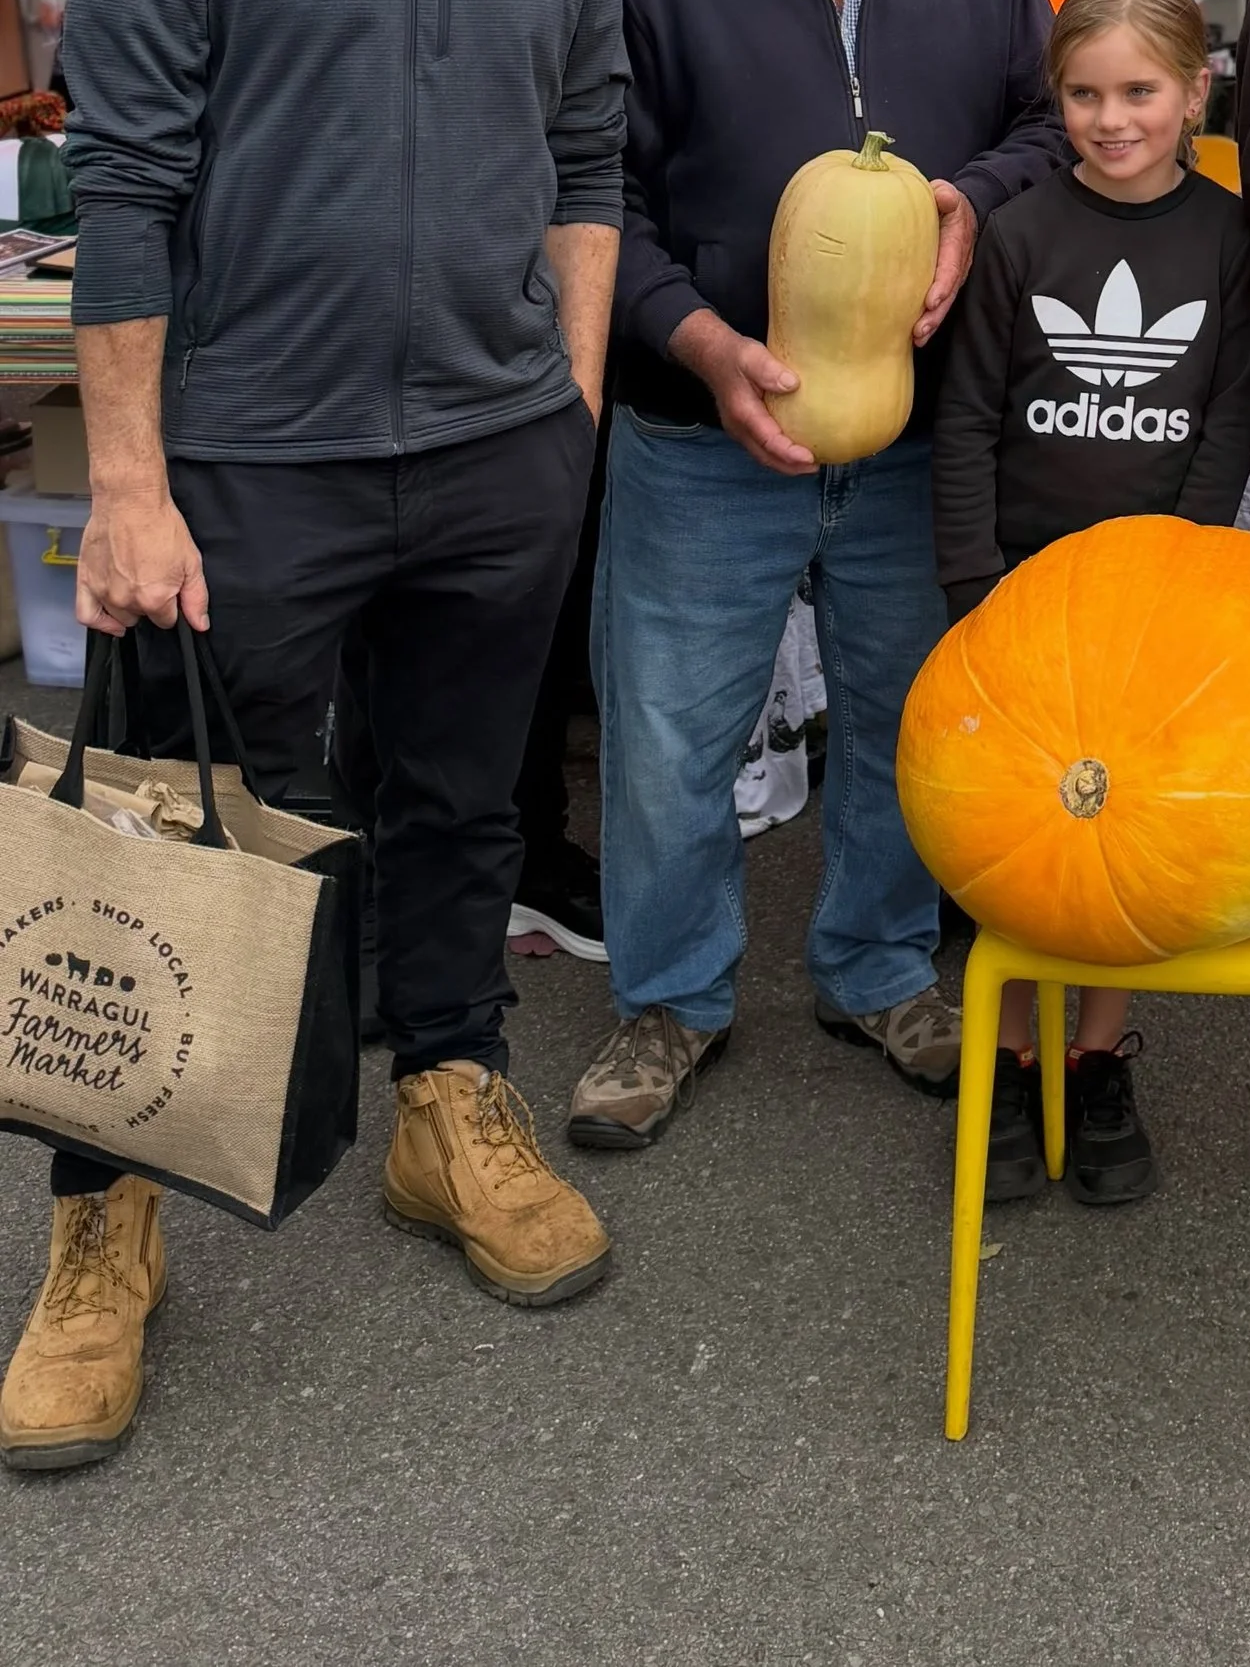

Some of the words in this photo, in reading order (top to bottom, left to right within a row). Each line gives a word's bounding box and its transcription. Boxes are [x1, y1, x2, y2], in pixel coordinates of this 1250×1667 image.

[1026, 392, 1190, 443] adidas
[0, 896, 64, 949] AKERS
[91, 899, 145, 931] SHOP
[149, 932, 193, 999] LOCAL
[20, 967, 151, 1033] WARRAGUL
[1, 997, 148, 1065] Farmers
[171, 1033, 194, 1079] BUY
[6, 1036, 126, 1091] Market
[126, 1085, 173, 1129] FRESH
